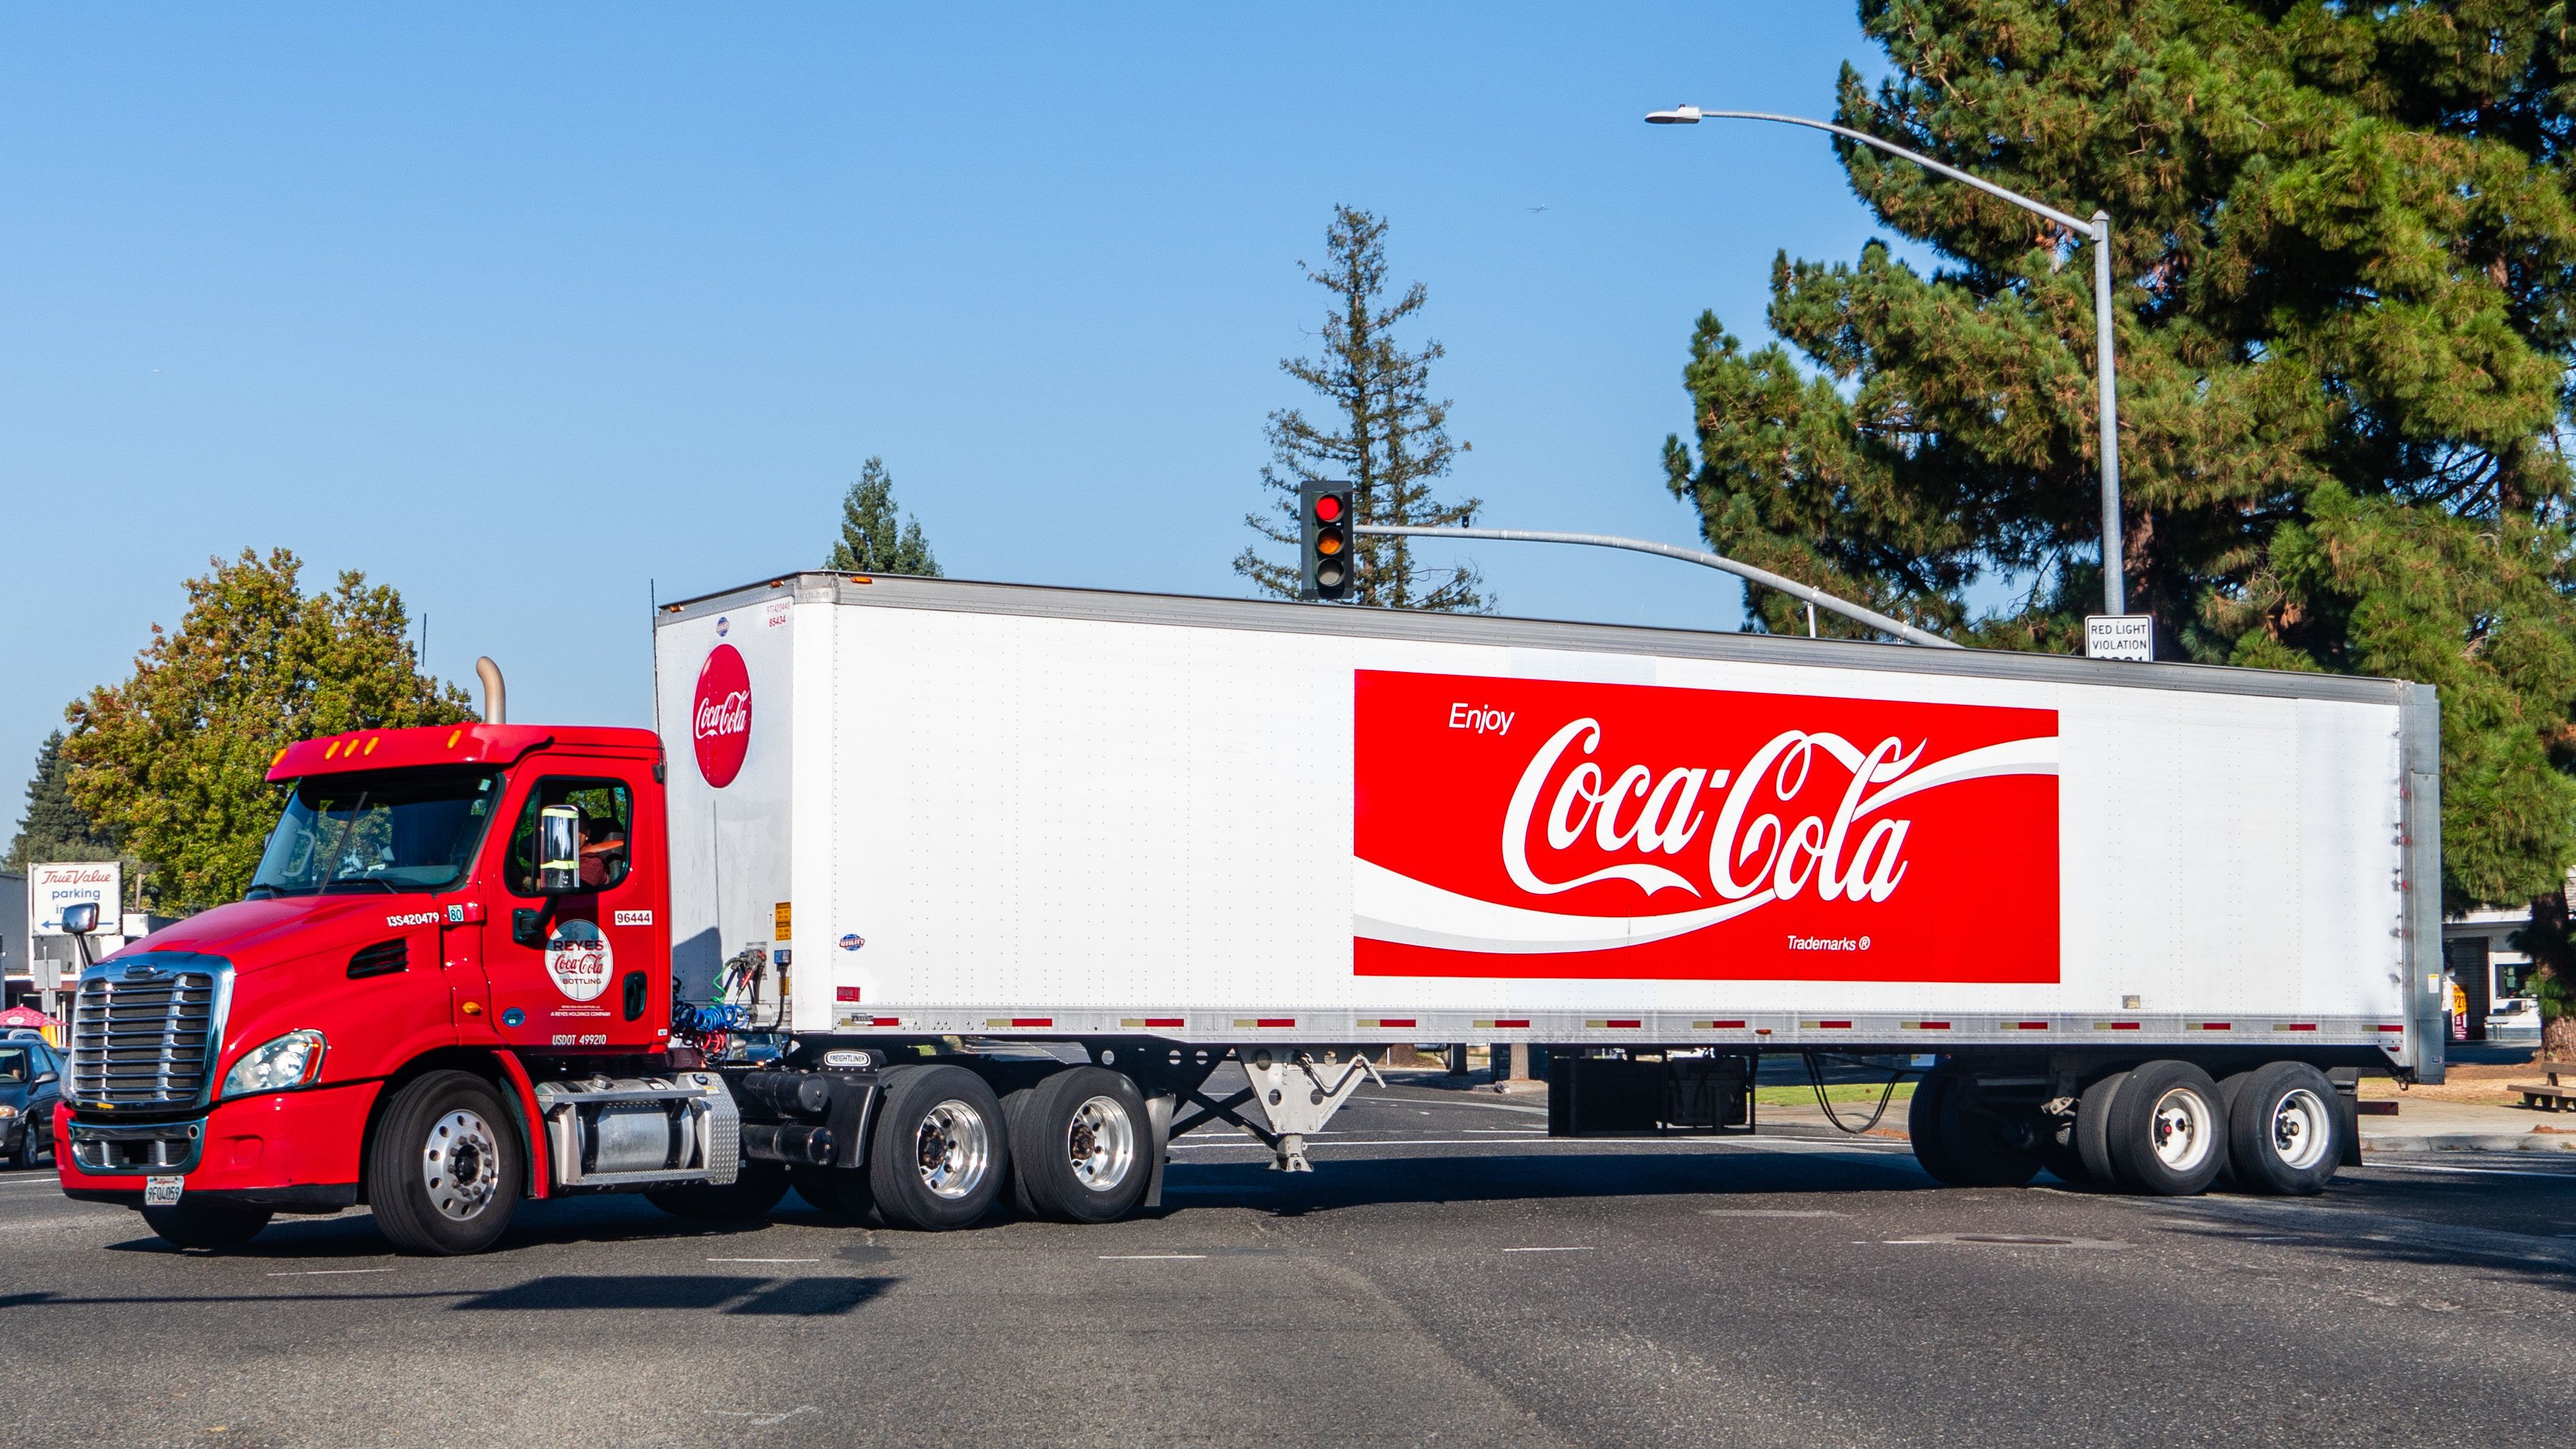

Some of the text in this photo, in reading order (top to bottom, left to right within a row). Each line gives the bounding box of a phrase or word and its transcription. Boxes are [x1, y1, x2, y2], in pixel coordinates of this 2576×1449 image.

[769, 615, 786, 628] 85434
[2091, 625, 2146, 634] RED LIGHT
[2093, 641, 2147, 650] VIOLATION
[695, 690, 750, 739] Coca-Cola
[1449, 703, 1514, 736] Enjoy
[1502, 718, 1927, 903] Coca-Cola
[52, 888, 100, 901] parking
[451, 909, 462, 921] 80
[617, 913, 650, 923] 96444
[553, 940, 604, 951] REYES
[840, 938, 865, 948] UTILITY
[1787, 935, 1856, 951] Trademarks
[555, 954, 605, 974] Coca-Cola
[552, 1035, 607, 1046] USDOT 499210
[829, 1054, 866, 1063] FREIGHTLINER
